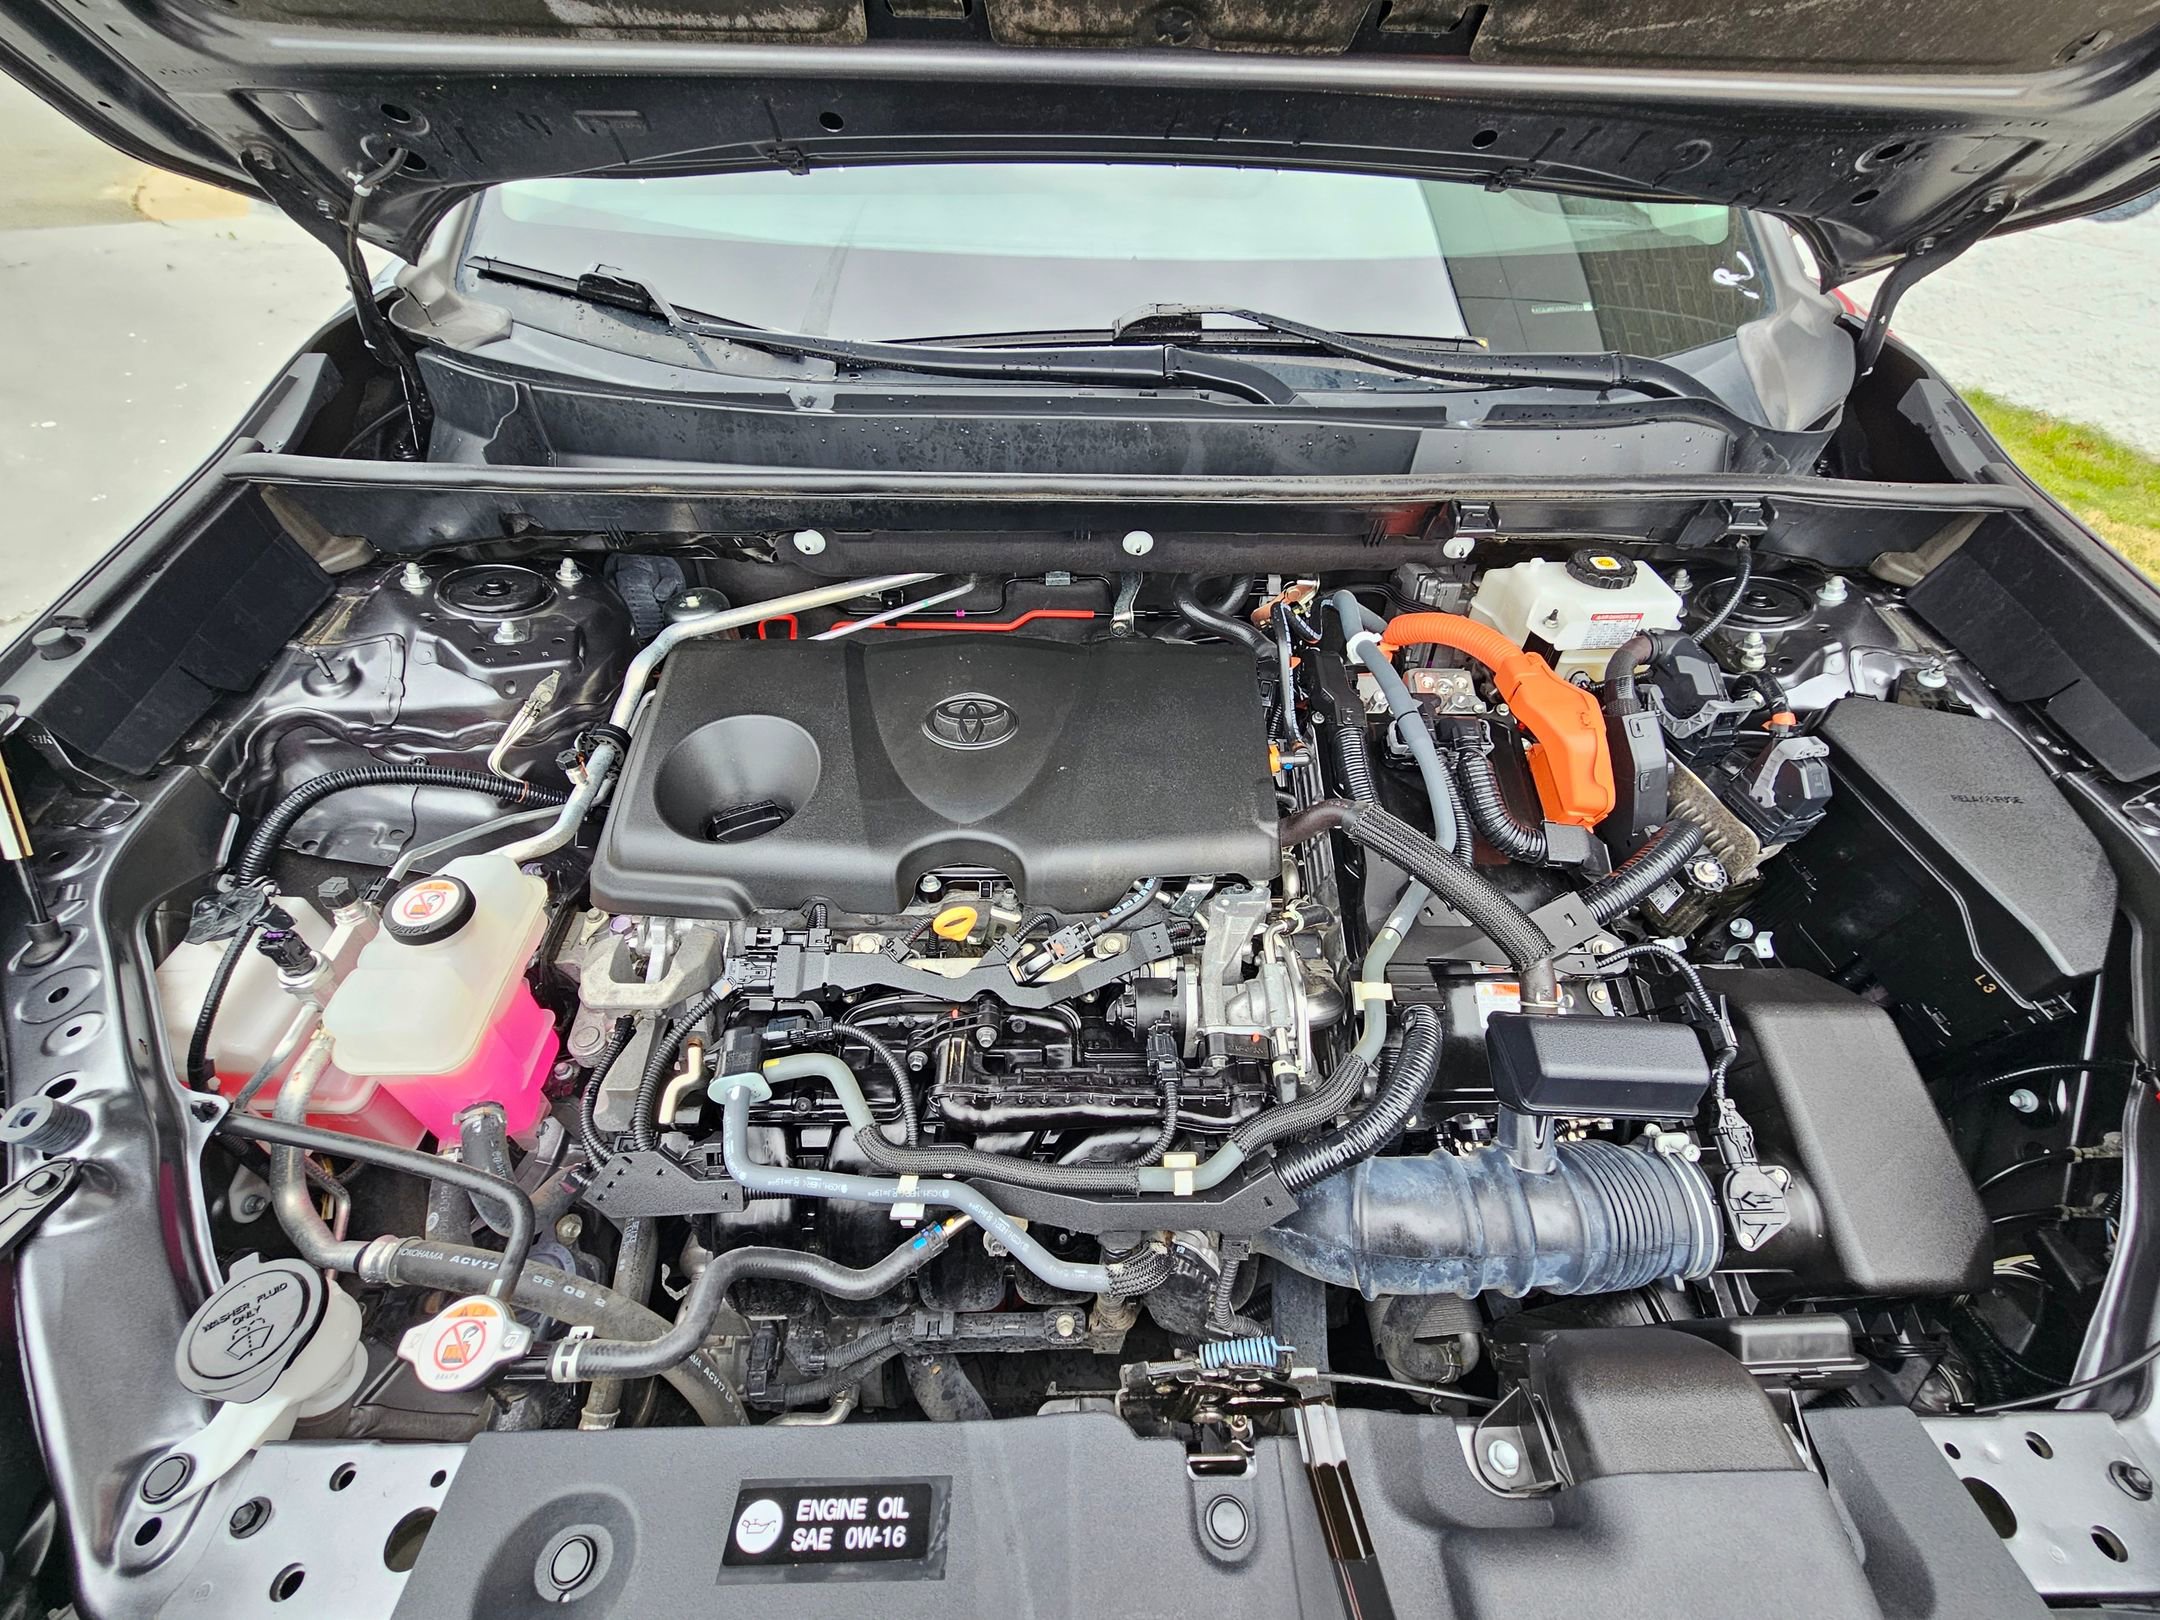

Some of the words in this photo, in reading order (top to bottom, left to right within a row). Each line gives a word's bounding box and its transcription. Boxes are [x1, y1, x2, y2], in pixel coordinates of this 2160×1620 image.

[1974, 973, 1997, 993] L3
[449, 1254, 499, 1271] ACV17
[202, 1302, 250, 1333] WASHER
[256, 1282, 288, 1303] FLUID
[232, 1305, 261, 1326] ONLY
[796, 1498, 867, 1521] ENGINE
[877, 1496, 909, 1519] OIL
[791, 1527, 834, 1552] SAE
[844, 1525, 907, 1550] 0W-16
